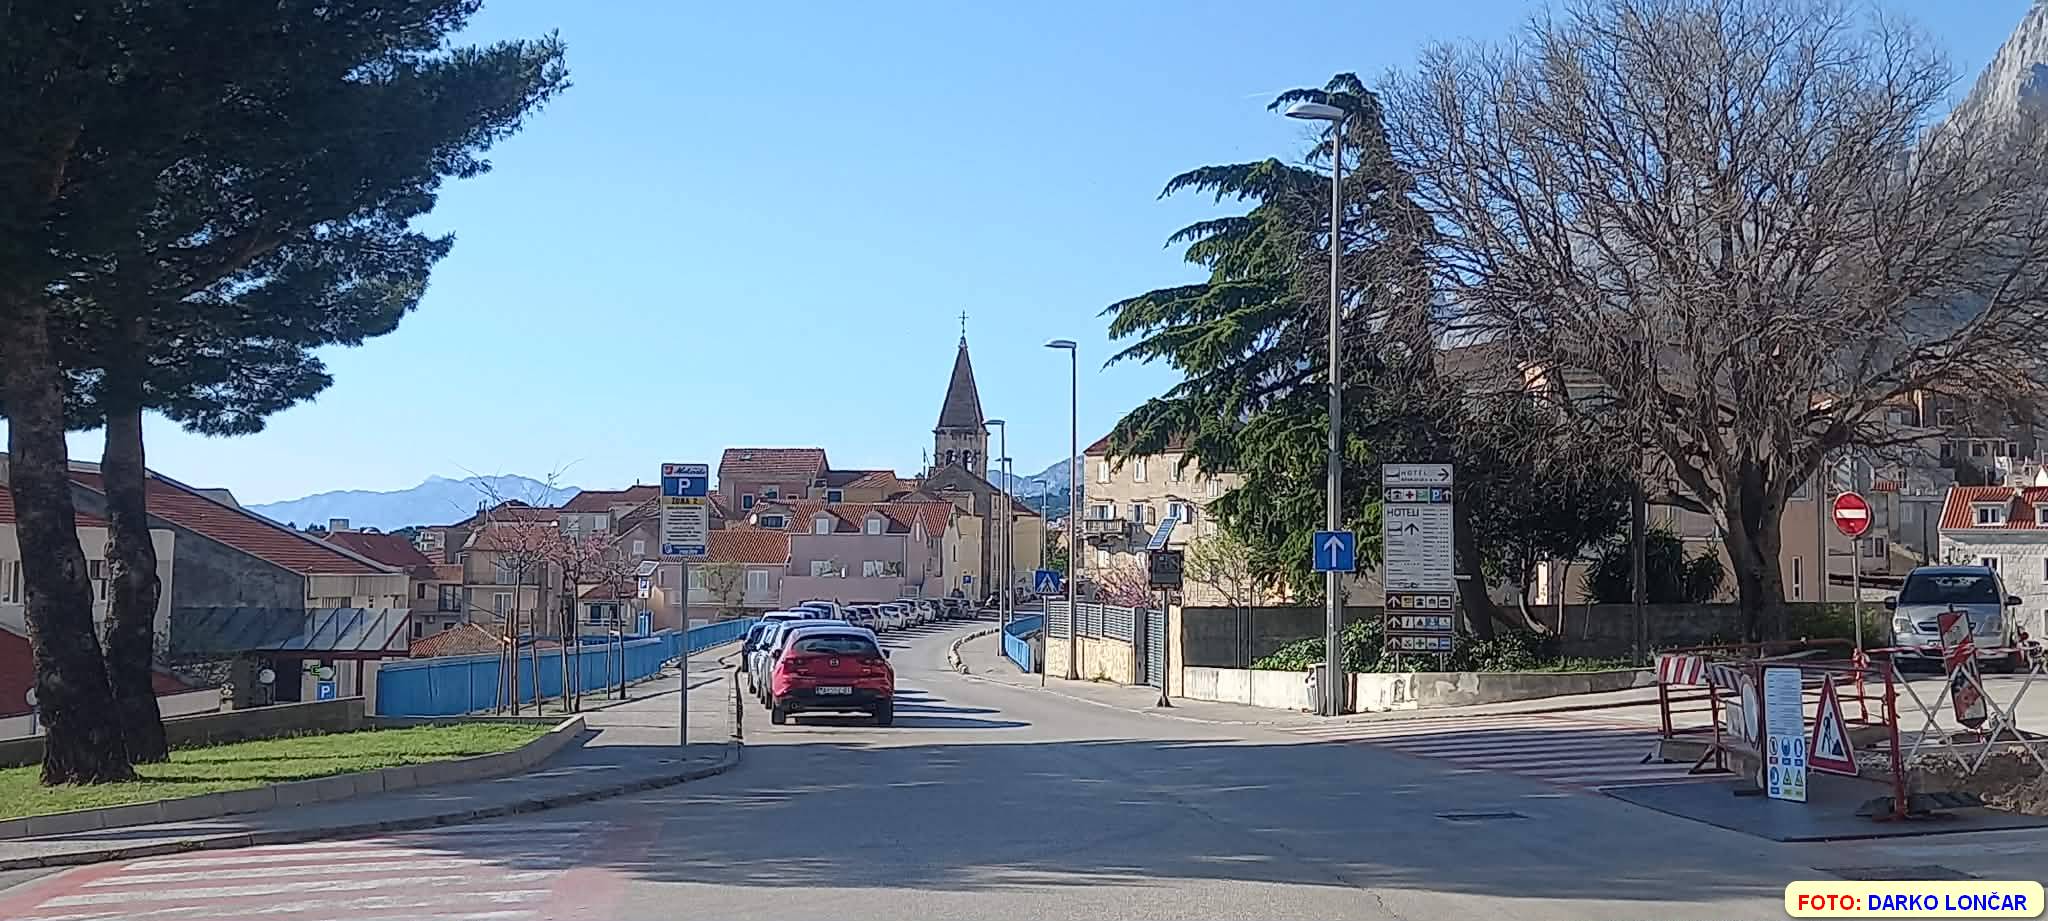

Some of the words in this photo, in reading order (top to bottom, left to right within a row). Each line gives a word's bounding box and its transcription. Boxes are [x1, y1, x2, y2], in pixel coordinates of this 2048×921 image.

[678, 478, 691, 495] P
[1432, 490, 1440, 501] P
[1387, 507, 1419, 517] HOTELI
[321, 685, 330, 699] P
